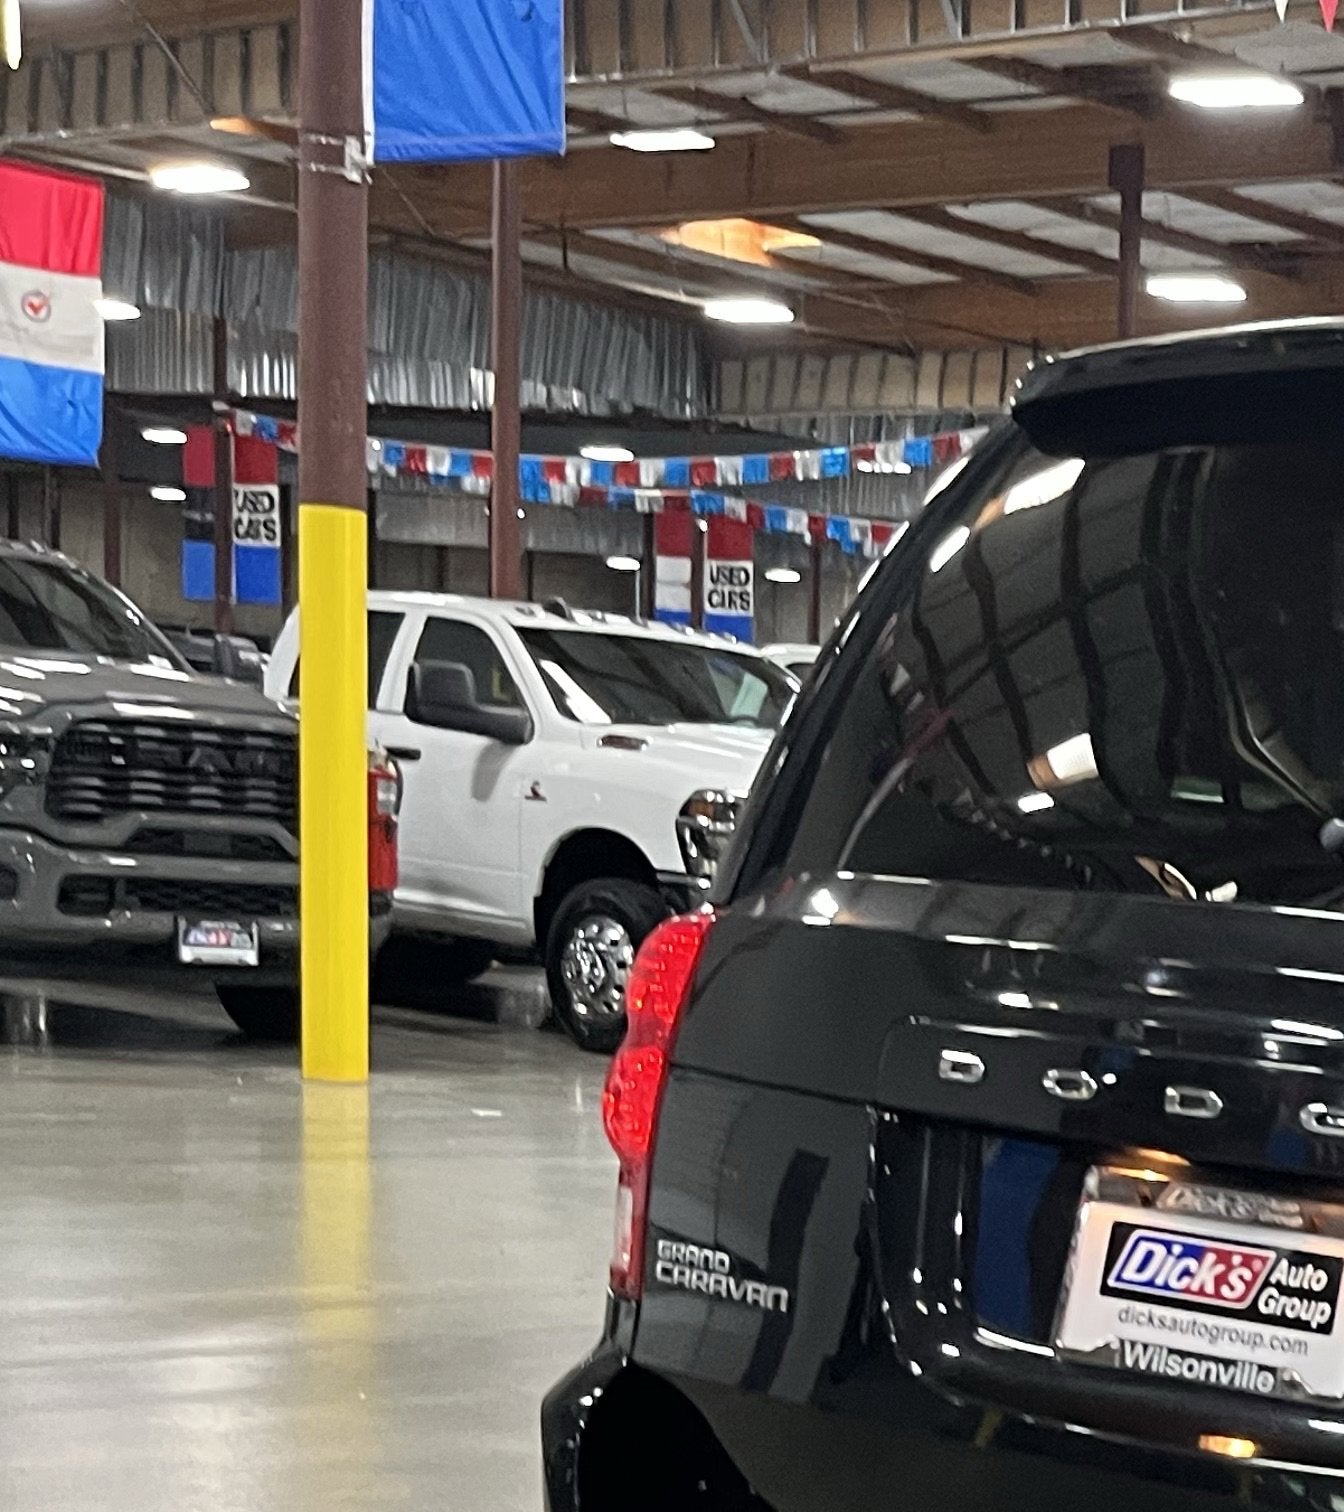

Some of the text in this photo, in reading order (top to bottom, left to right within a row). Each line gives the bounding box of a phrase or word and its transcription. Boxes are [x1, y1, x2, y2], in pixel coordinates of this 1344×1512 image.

[710, 566, 750, 586] USED
[657, 1239, 731, 1275] GRAND
[1120, 1239, 1254, 1300] Dick's
[1270, 1258, 1329, 1292] Auto
[656, 1259, 790, 1313] CARAVAN
[1258, 1286, 1332, 1329] Group
[1118, 1305, 1309, 1355] dicksautogroup.com
[1123, 1339, 1276, 1393] Wilsonville
